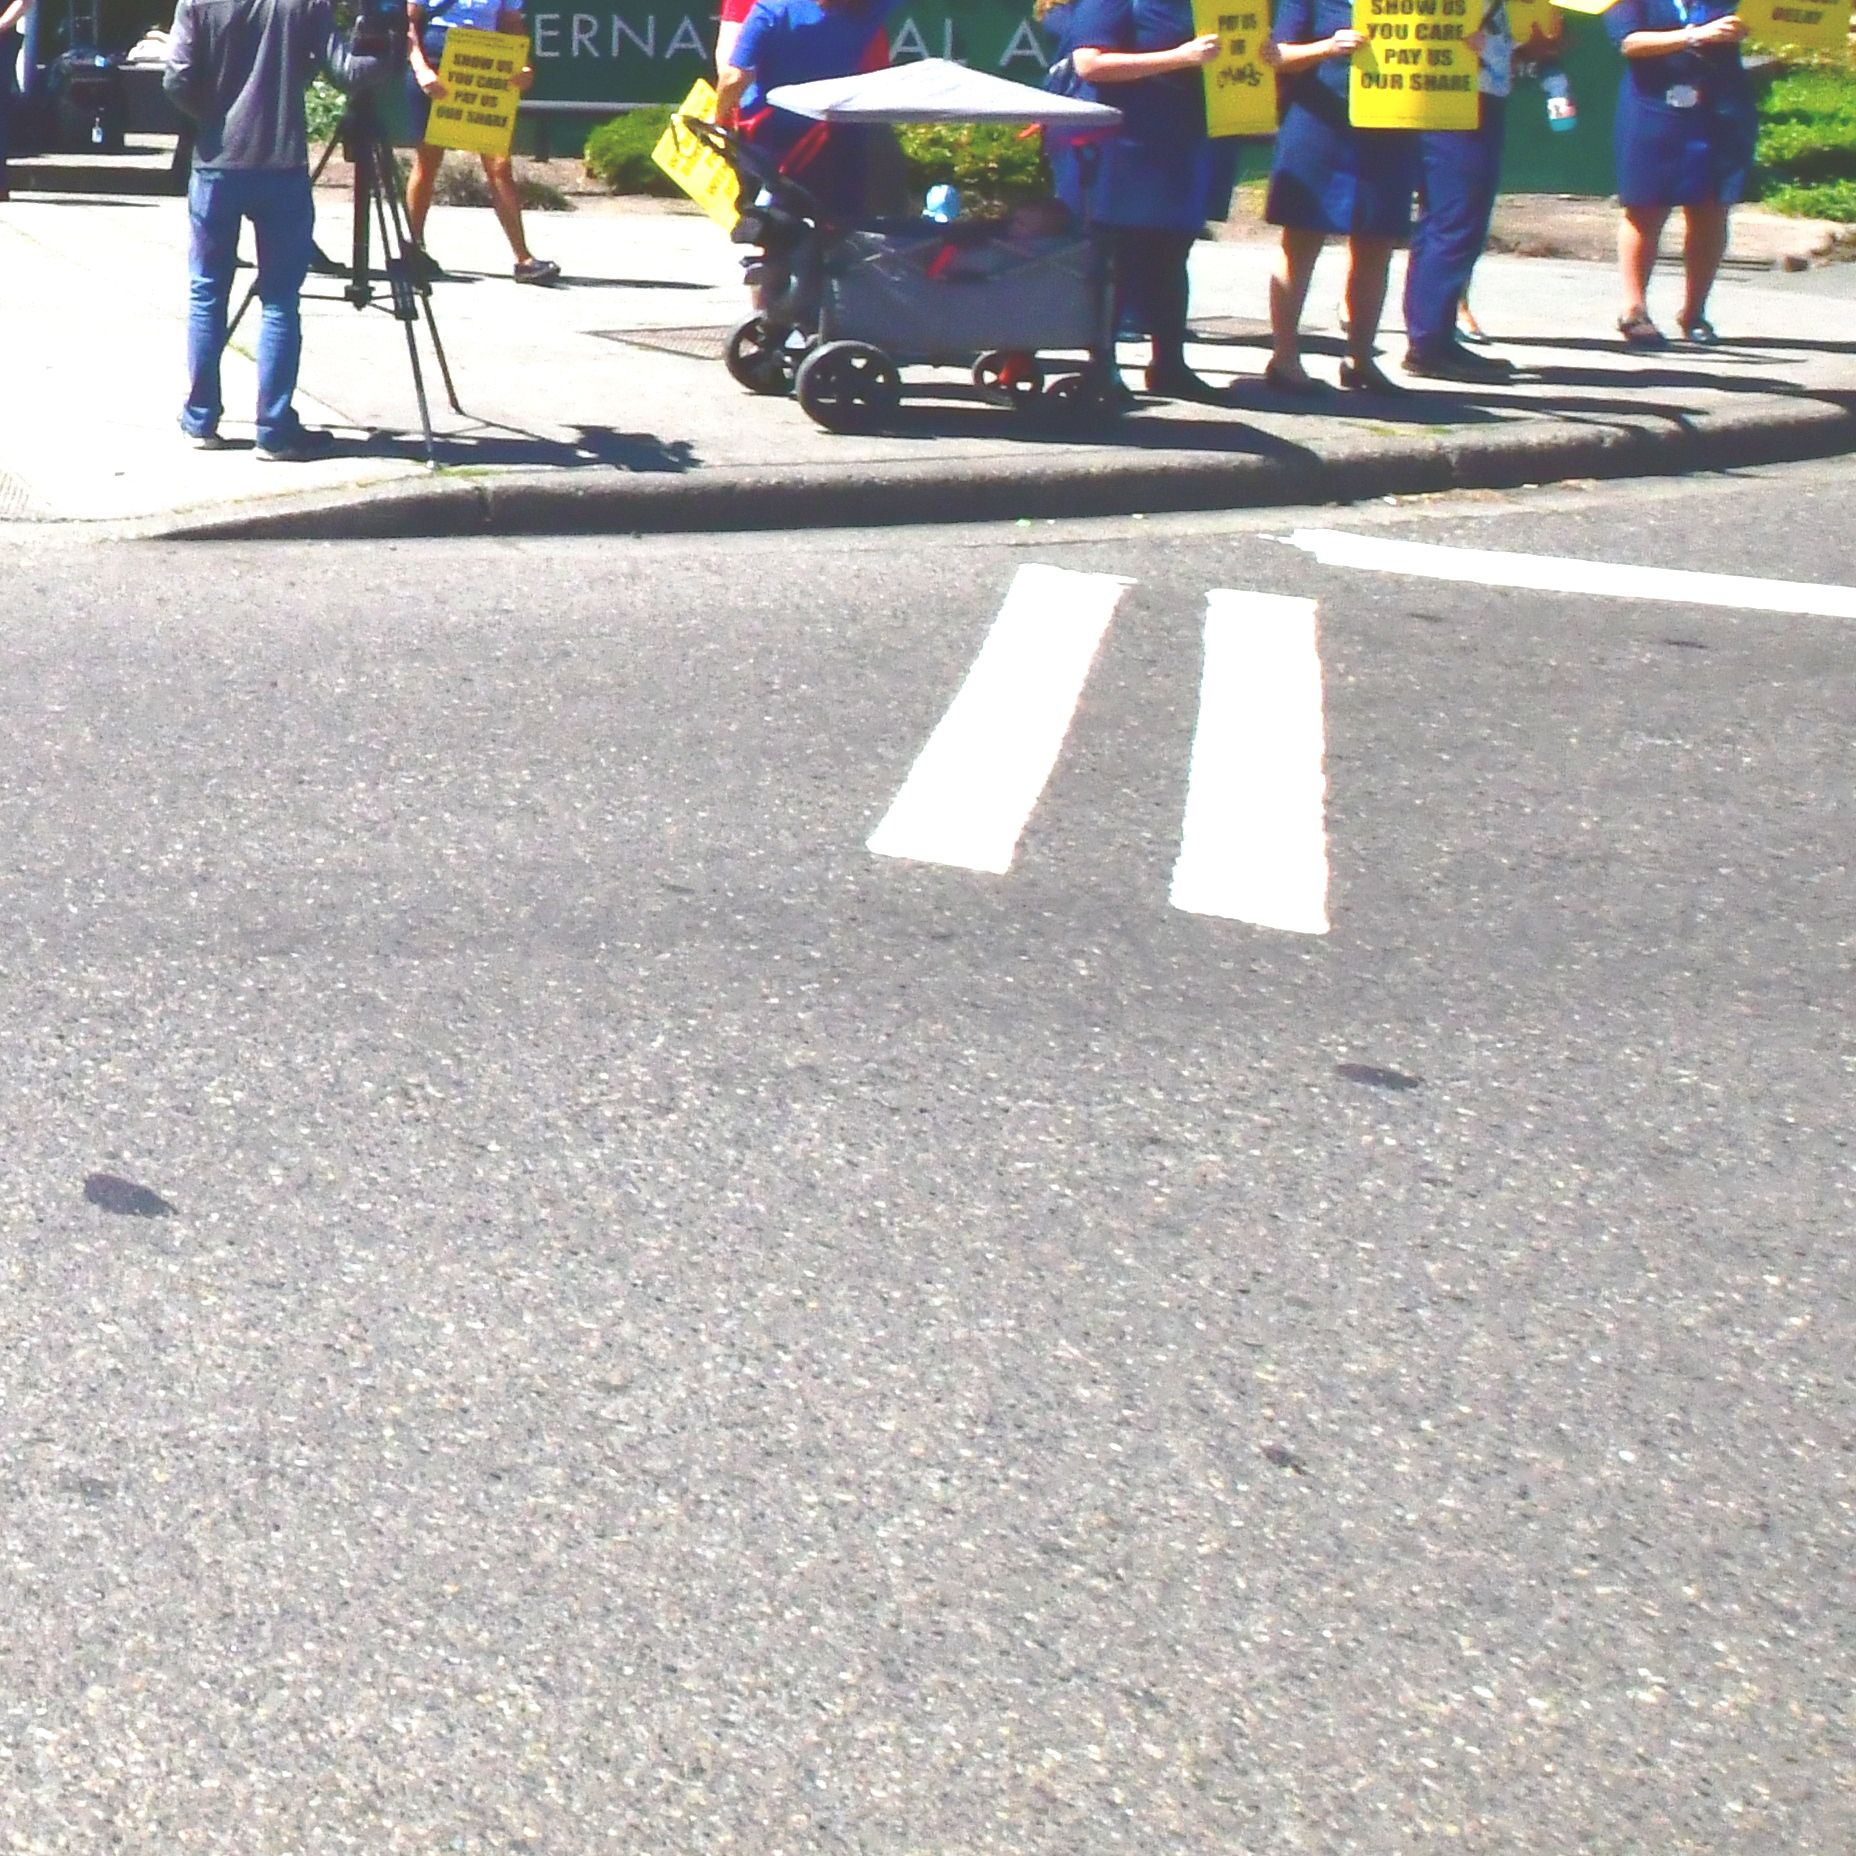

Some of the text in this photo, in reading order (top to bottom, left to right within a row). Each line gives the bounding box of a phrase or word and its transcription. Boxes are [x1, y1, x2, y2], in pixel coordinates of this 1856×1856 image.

[1442, 0, 1467, 16] US
[1771, 7, 1824, 25] DELAY
[1217, 13, 1257, 32] PAY US
[1366, 23, 1464, 42] YOU CARE
[453, 53, 514, 74] SHOW US
[1384, 48, 1454, 66] PAY US
[448, 71, 509, 91] YOU CARE
[1360, 72, 1472, 92] OUR SHARE
[454, 91, 499, 108] PAY US
[436, 106, 509, 128] OUR SHARE
